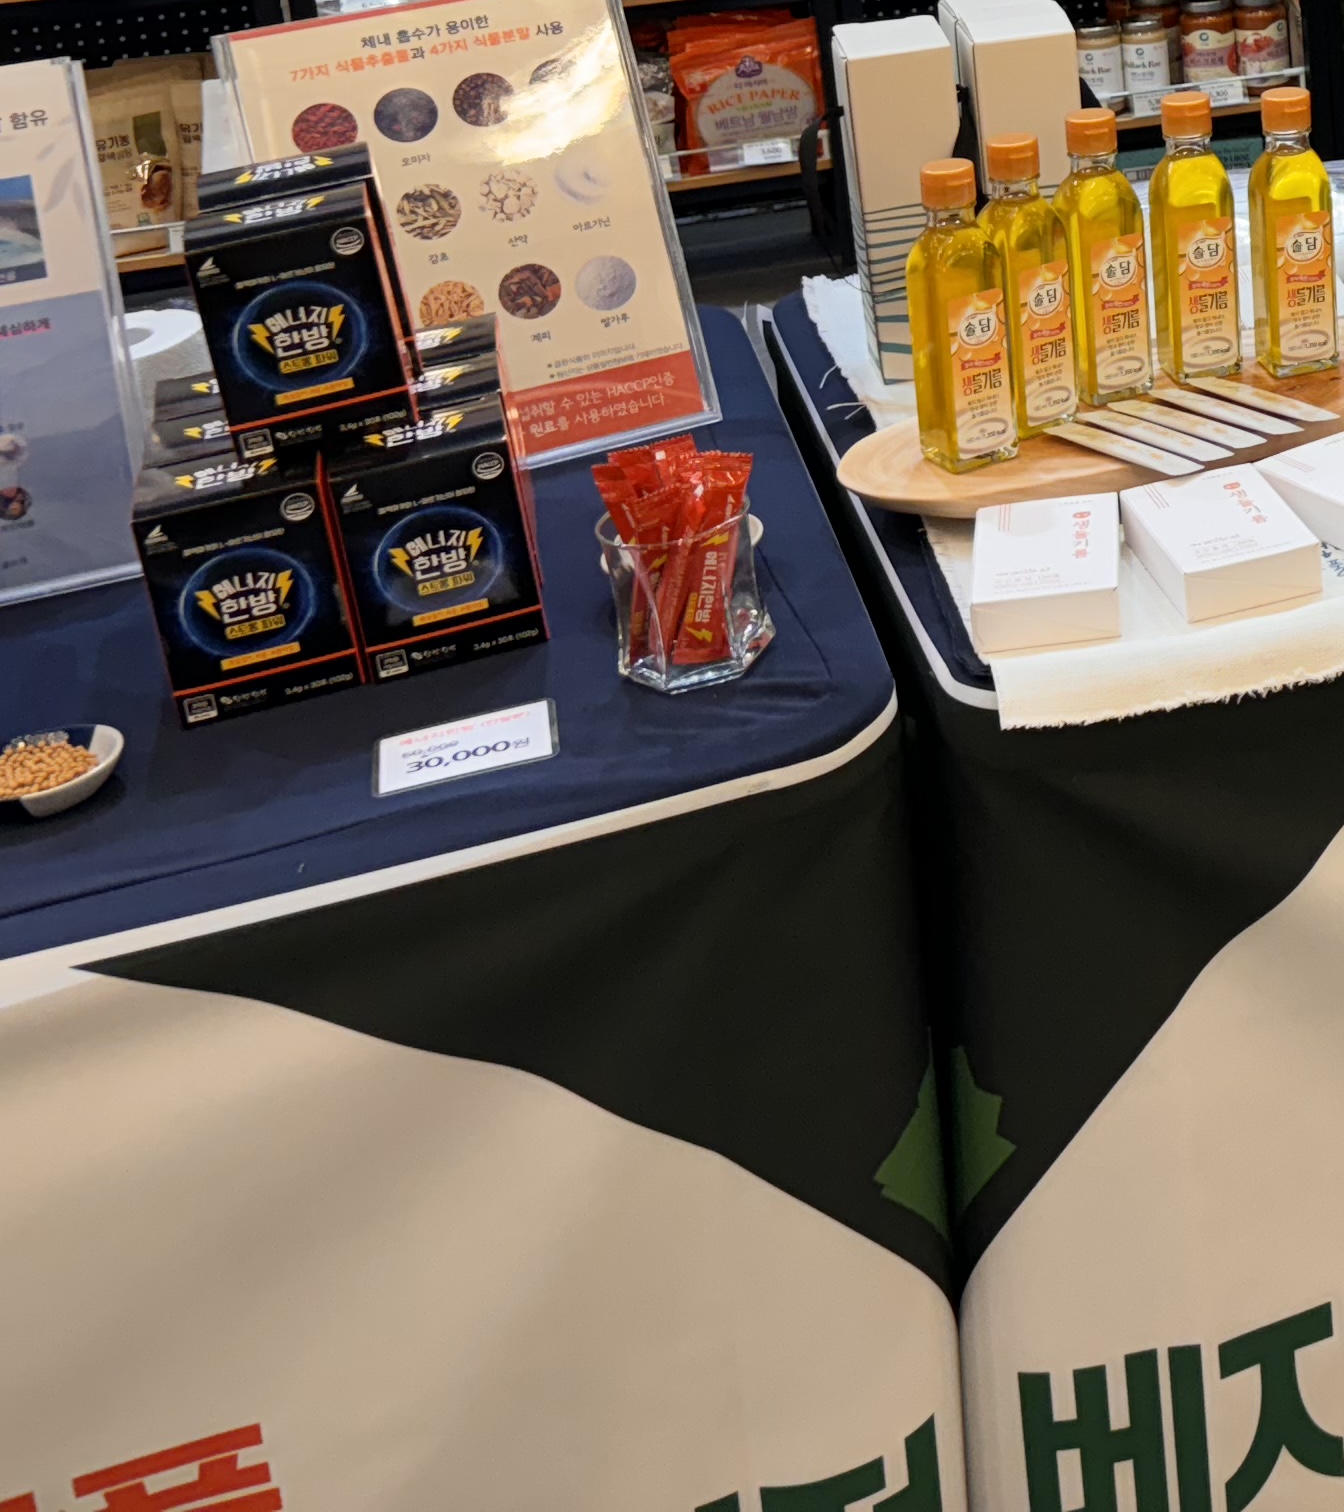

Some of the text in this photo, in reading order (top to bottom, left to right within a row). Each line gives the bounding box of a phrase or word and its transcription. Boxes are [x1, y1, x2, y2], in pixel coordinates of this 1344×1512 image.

[361, 15, 489, 50] 체내 흡수가 용이한
[289, 61, 330, 82] 7가지
[429, 38, 468, 57] 4가지
[473, 26, 531, 48] 식물분말
[536, 21, 564, 37] 사용
[9, 109, 48, 130] 함유
[401, 152, 431, 167] 오미자
[1188, 291, 1228, 314] 생들기름
[1287, 284, 1326, 308] 생들기름
[264, 305, 327, 336] 에너지
[1102, 308, 1140, 335] 생들기름
[274, 326, 329, 358] 한방
[1030, 337, 1067, 366] 생들기름
[560, 396, 574, 411] 수
[576, 391, 602, 407] 있는
[605, 372, 676, 398] HACCP인증
[961, 368, 1002, 395] 생들기름
[529, 393, 665, 438] 원료를 사용하였습니다
[405, 529, 466, 556] 에너지
[412, 548, 469, 580] 한방
[212, 571, 275, 597] 에너지
[220, 591, 277, 623] 한방
